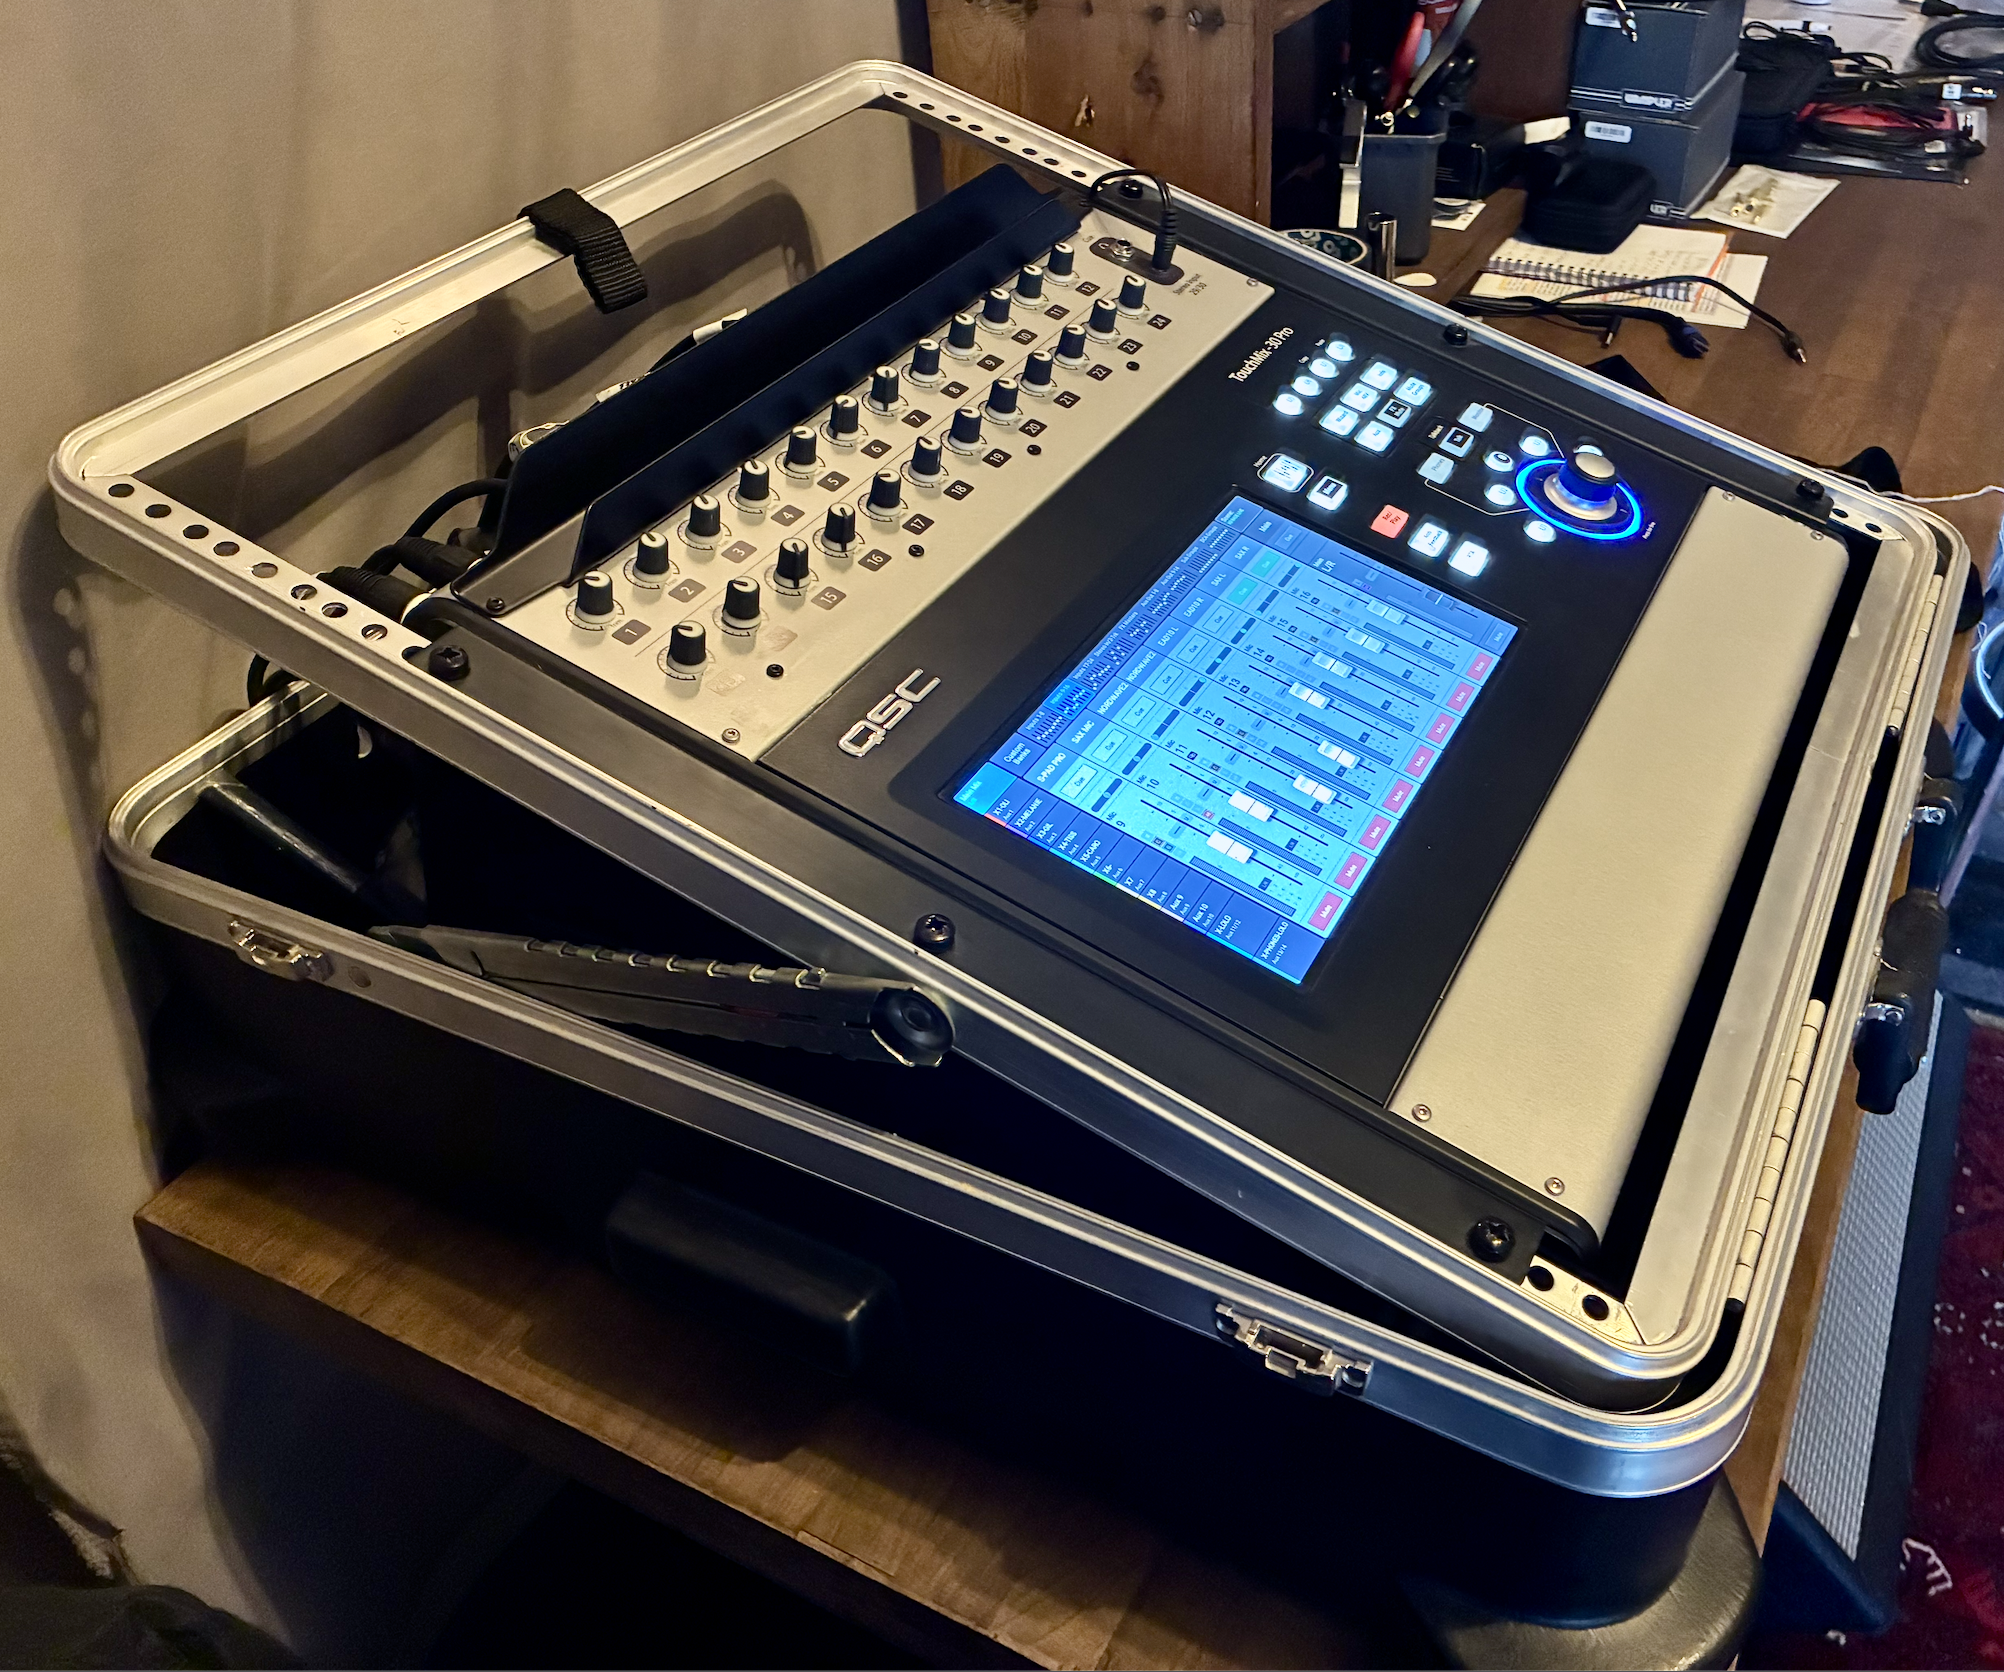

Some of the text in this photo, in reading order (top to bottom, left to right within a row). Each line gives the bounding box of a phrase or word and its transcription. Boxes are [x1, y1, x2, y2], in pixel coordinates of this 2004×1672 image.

[1172, 273, 1202, 295] Stereo Input
[1188, 282, 1208, 295] 29/30
[1271, 324, 1296, 340] Pro
[1410, 383, 1425, 396] Groups
[1252, 454, 1268, 467] Home
[1430, 457, 1445, 471] Phones
[1233, 549, 1246, 559] SAX
[1321, 559, 1336, 572] L/R
[1210, 575, 1223, 586] SAX
[1299, 590, 1311, 599] 16
[1182, 600, 1201, 617] EAD10
[1276, 617, 1289, 628] 15
[1156, 628, 1176, 646] EAD10
[1252, 647, 1265, 657] 14
[1227, 677, 1241, 688] 13
[1096, 681, 1129, 714] NORDWAVE2
[838, 667, 941, 757] QSC
[1201, 709, 1215, 720] 12
[1070, 719, 1095, 744] SAX MIC
[1002, 741, 1026, 763] Custom
[1174, 743, 1188, 754] 11
[1013, 747, 1031, 765] Banks
[1035, 751, 1067, 783] S-PAD PRO
[1145, 778, 1160, 790] 10
[1014, 797, 1043, 827] X2-MELANIE
[1168, 897, 1182, 910] Aux
[1191, 909, 1204, 922] Aux
[1214, 914, 1232, 934] X-LOLO
[1260, 920, 1289, 959] X-PHONES-LOLO
